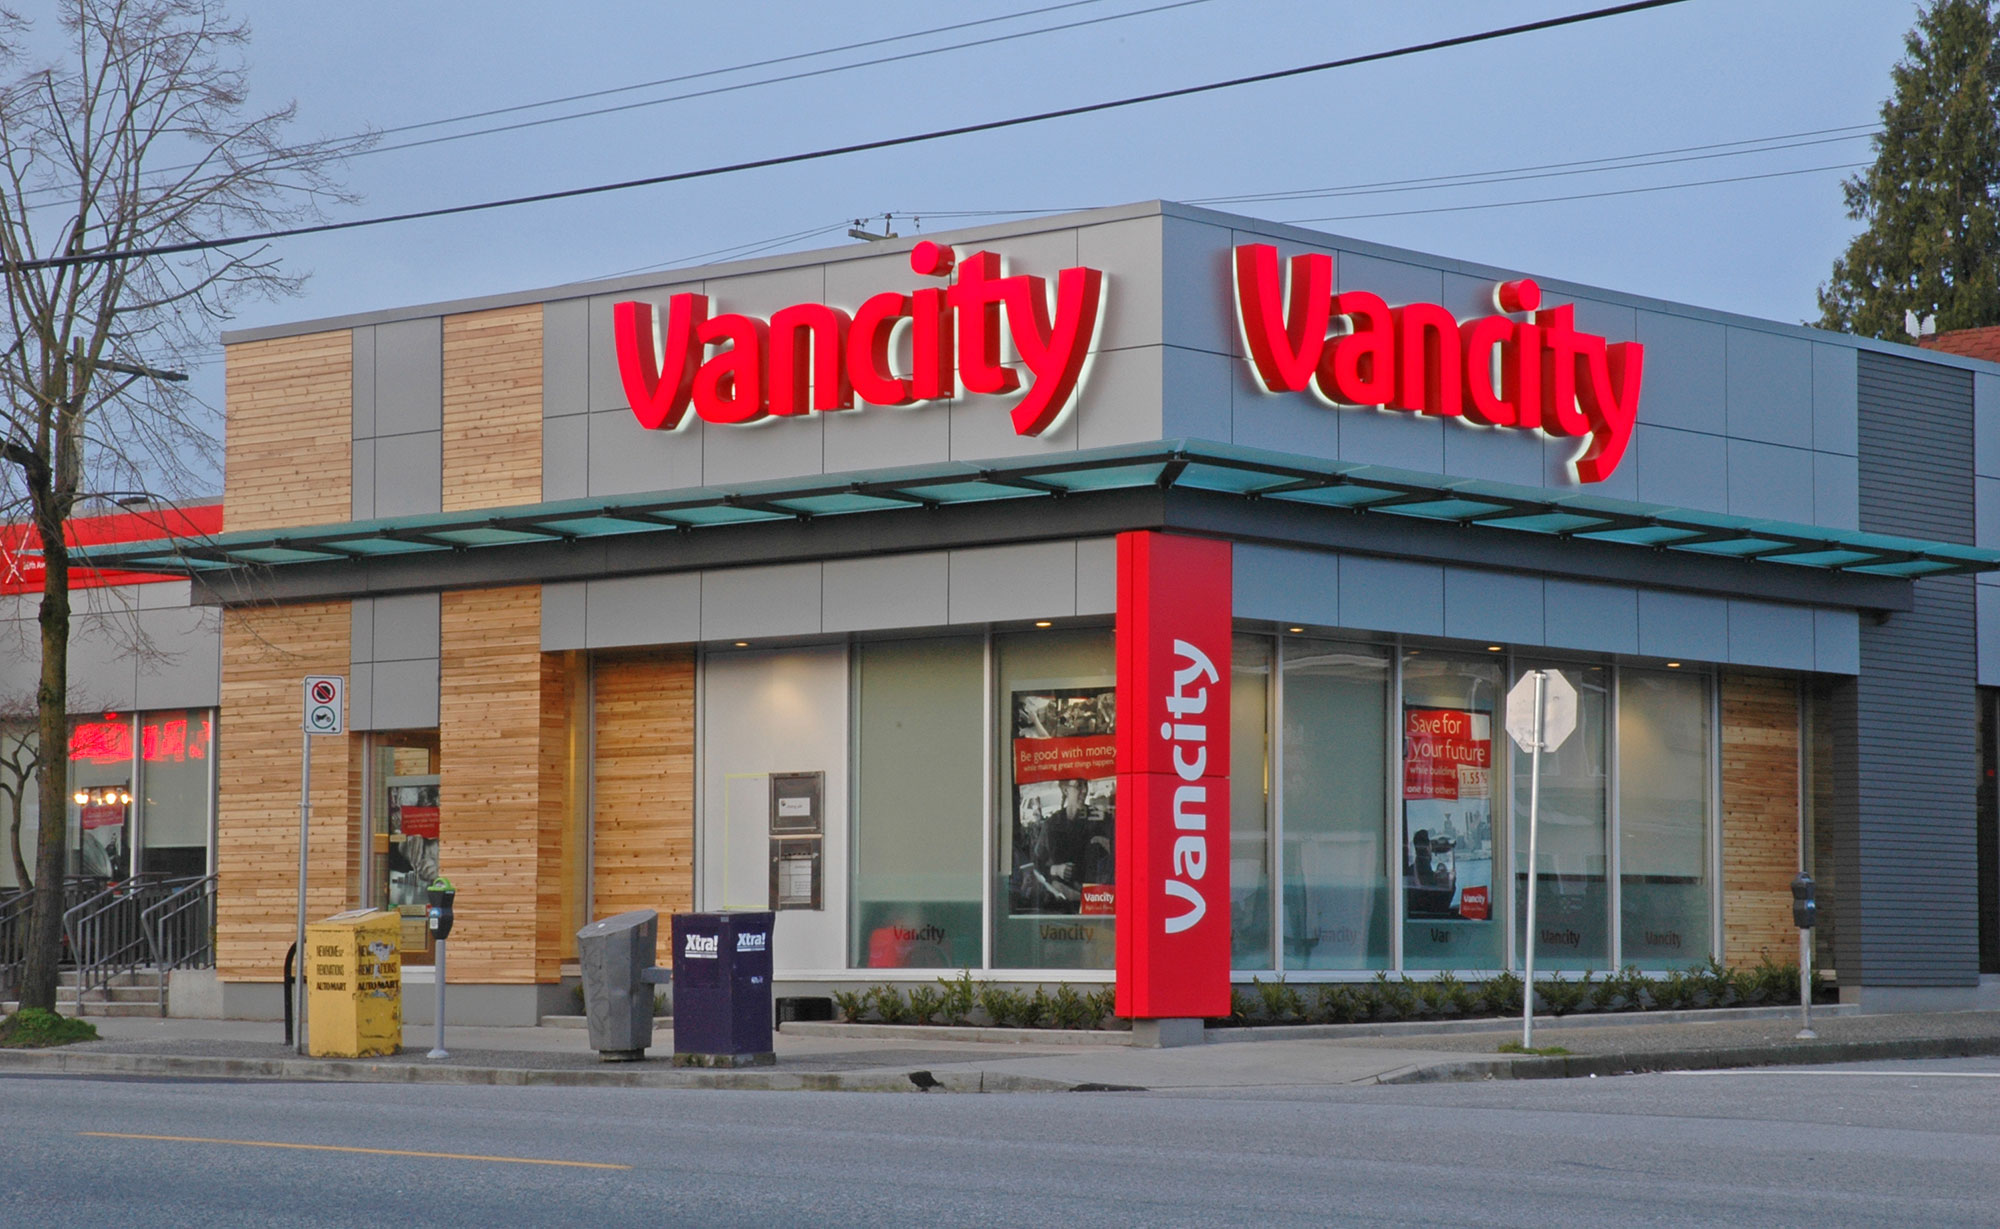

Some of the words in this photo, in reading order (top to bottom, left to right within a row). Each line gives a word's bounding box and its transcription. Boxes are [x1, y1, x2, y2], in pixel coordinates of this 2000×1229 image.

[613, 240, 1103, 437] Vancity
[1234, 243, 1644, 484] Vancity
[1410, 713, 1441, 734] Save
[1442, 713, 1462, 735] for
[1020, 750, 1032, 762] Be
[1033, 747, 1058, 764] good
[1061, 746, 1083, 759] with
[1085, 745, 1117, 758] money
[1411, 742, 1443, 762] your
[1445, 739, 1485, 762] future
[1409, 765, 1428, 775] while
[1430, 766, 1456, 779] building
[1160, 638, 1219, 934] Vancity
[1423, 784, 1433, 793] for
[1083, 892, 1114, 904] Vancity
[1463, 894, 1485, 905] Vancity
[685, 933, 719, 952] Xtra!
[737, 932, 766, 946] Xtra!
[893, 924, 945, 945] Vancity
[1040, 923, 1094, 944] Vancity
[1541, 928, 1581, 948] Vancity
[1645, 930, 1682, 949] Vancity
